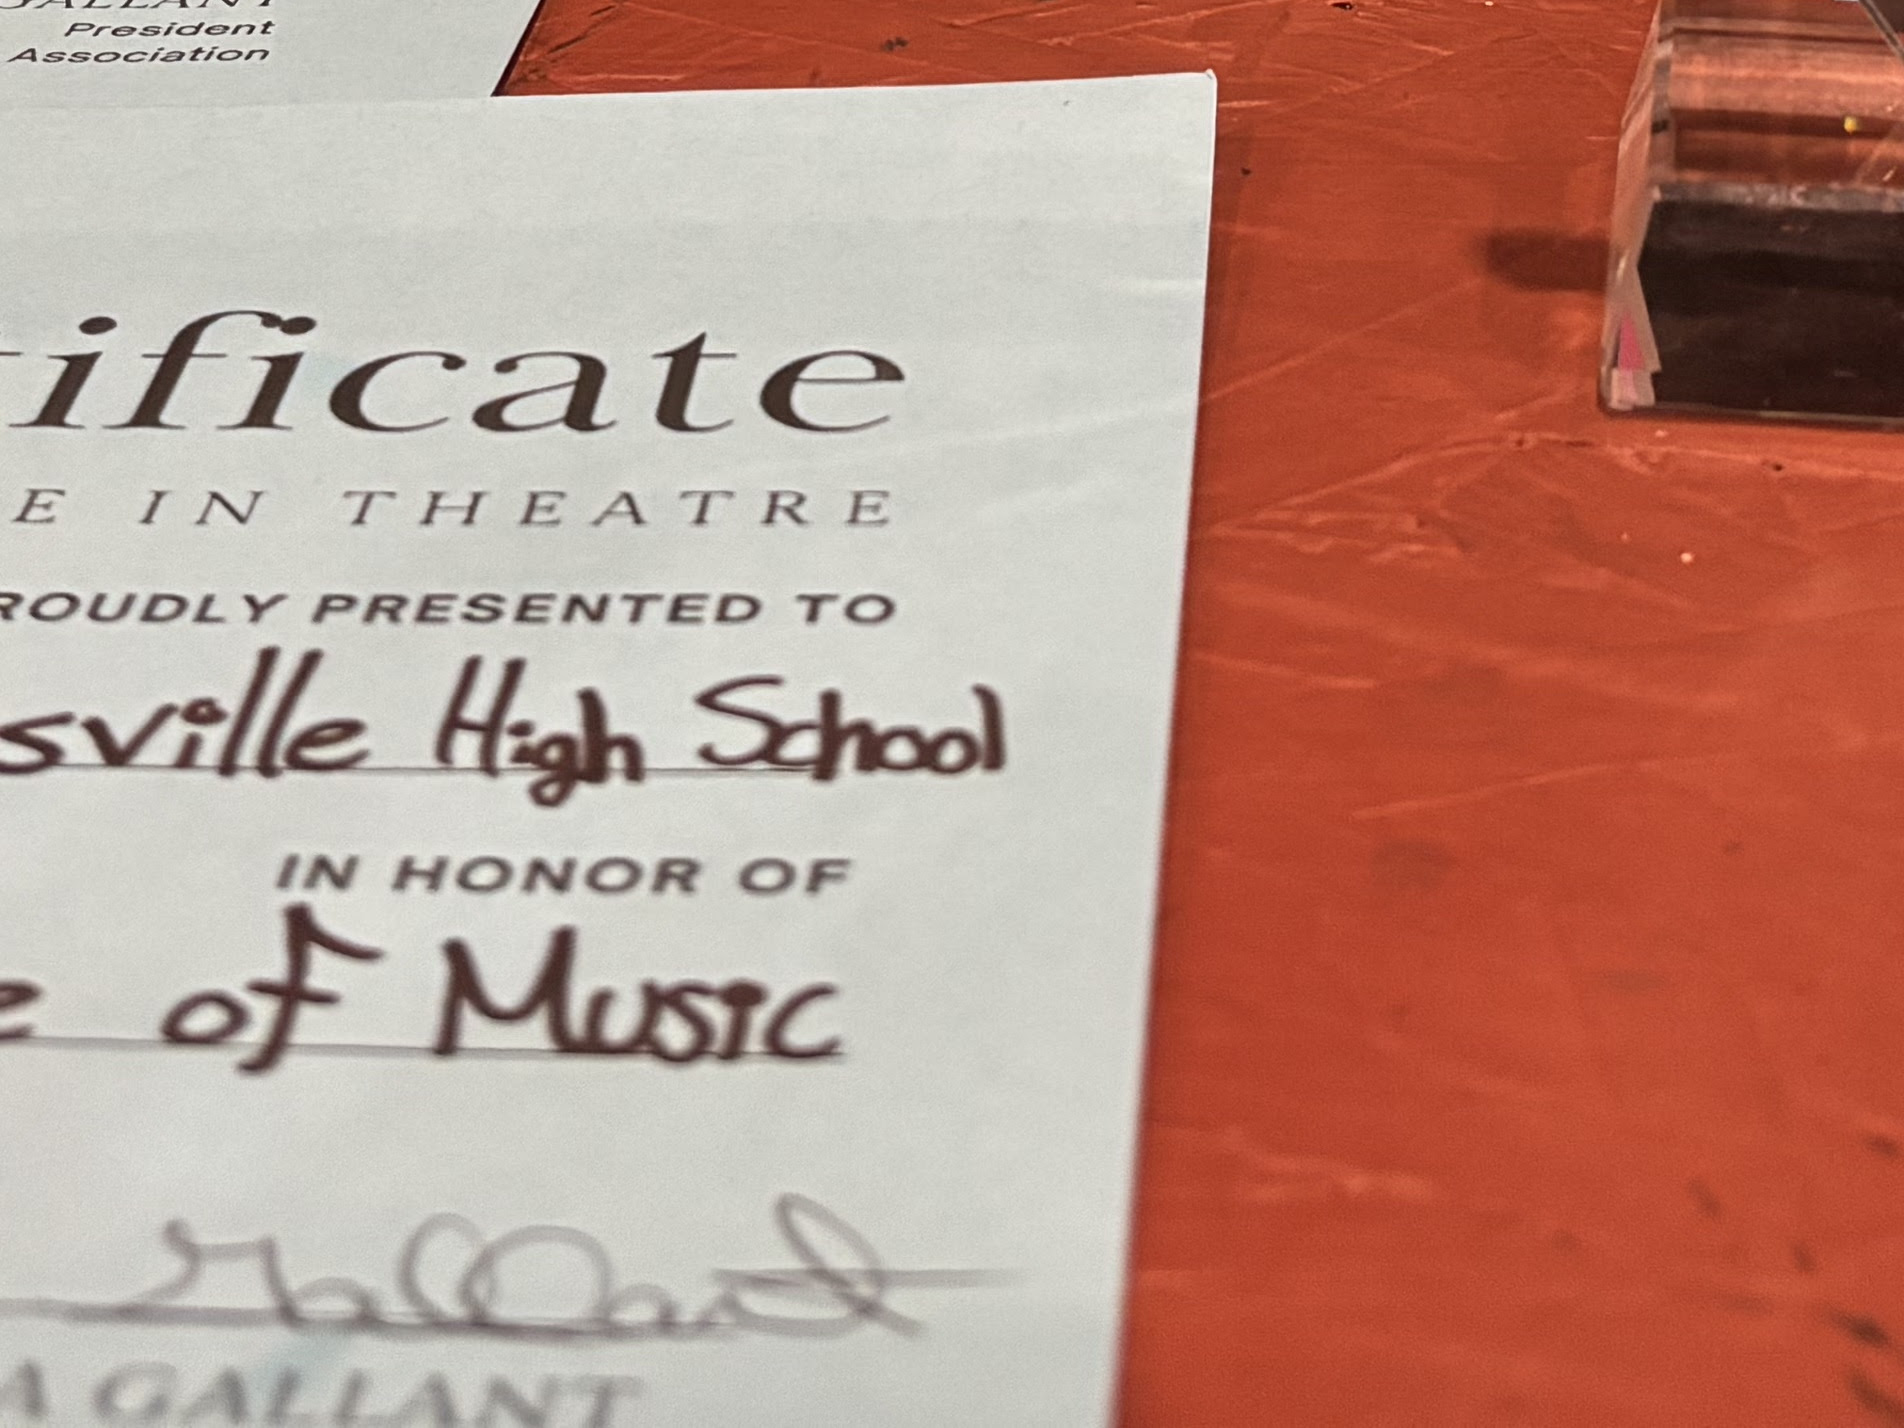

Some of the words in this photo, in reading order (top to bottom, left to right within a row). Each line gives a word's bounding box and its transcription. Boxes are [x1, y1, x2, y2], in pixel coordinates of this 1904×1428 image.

[63, 18, 277, 40] President
[14, 42, 274, 66] Association
[136, 488, 270, 528] IN
[341, 486, 900, 531] THEATRE
[308, 589, 772, 629] PRESENTED
[789, 591, 901, 628] TO
[434, 654, 646, 808] High
[690, 672, 1009, 784] School
[275, 855, 365, 895] IN
[389, 856, 706, 898] HONOR
[732, 856, 858, 899] OF
[159, 898, 388, 1076] of
[429, 924, 851, 1068] Music
[92, 1362, 646, 1428] GALLANT
